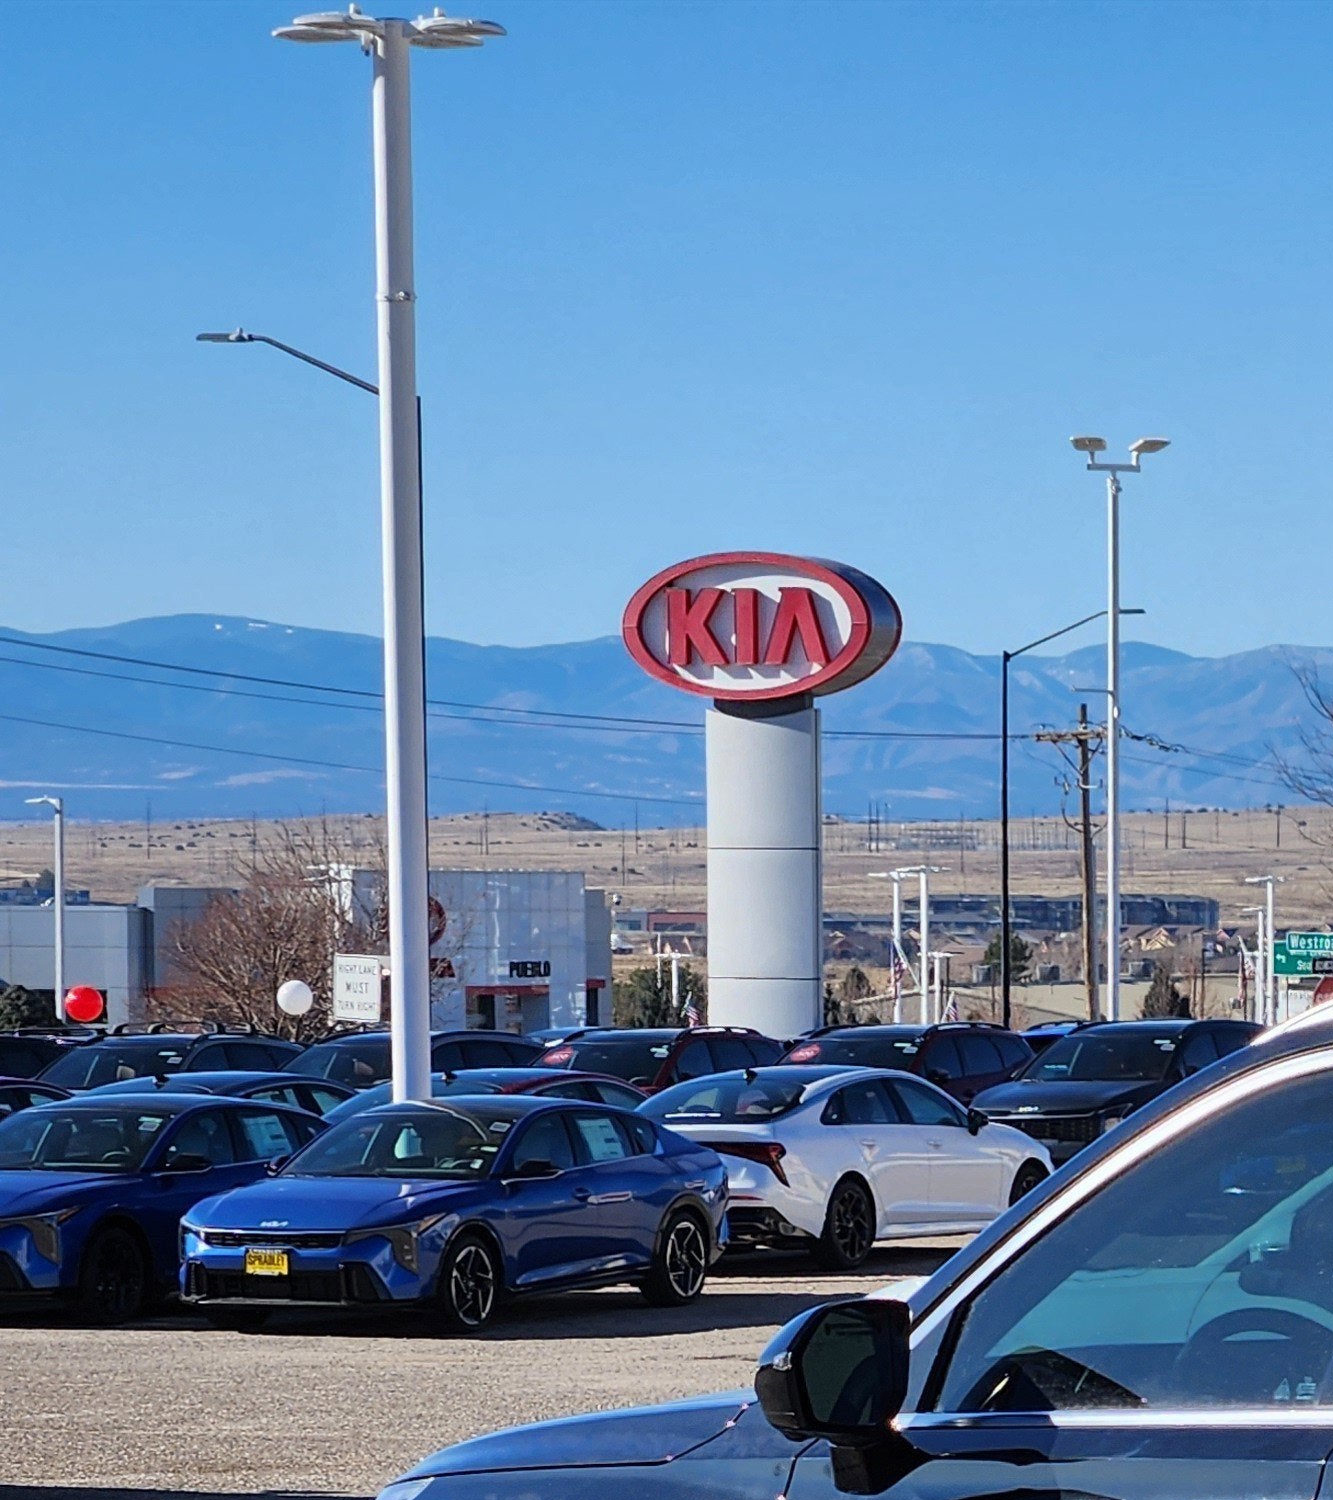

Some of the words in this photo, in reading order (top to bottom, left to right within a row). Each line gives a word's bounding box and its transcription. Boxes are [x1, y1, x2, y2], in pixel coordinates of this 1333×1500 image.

[664, 586, 832, 667] KIA
[509, 960, 552, 979] PUEBLO
[345, 981, 370, 994] MUST
